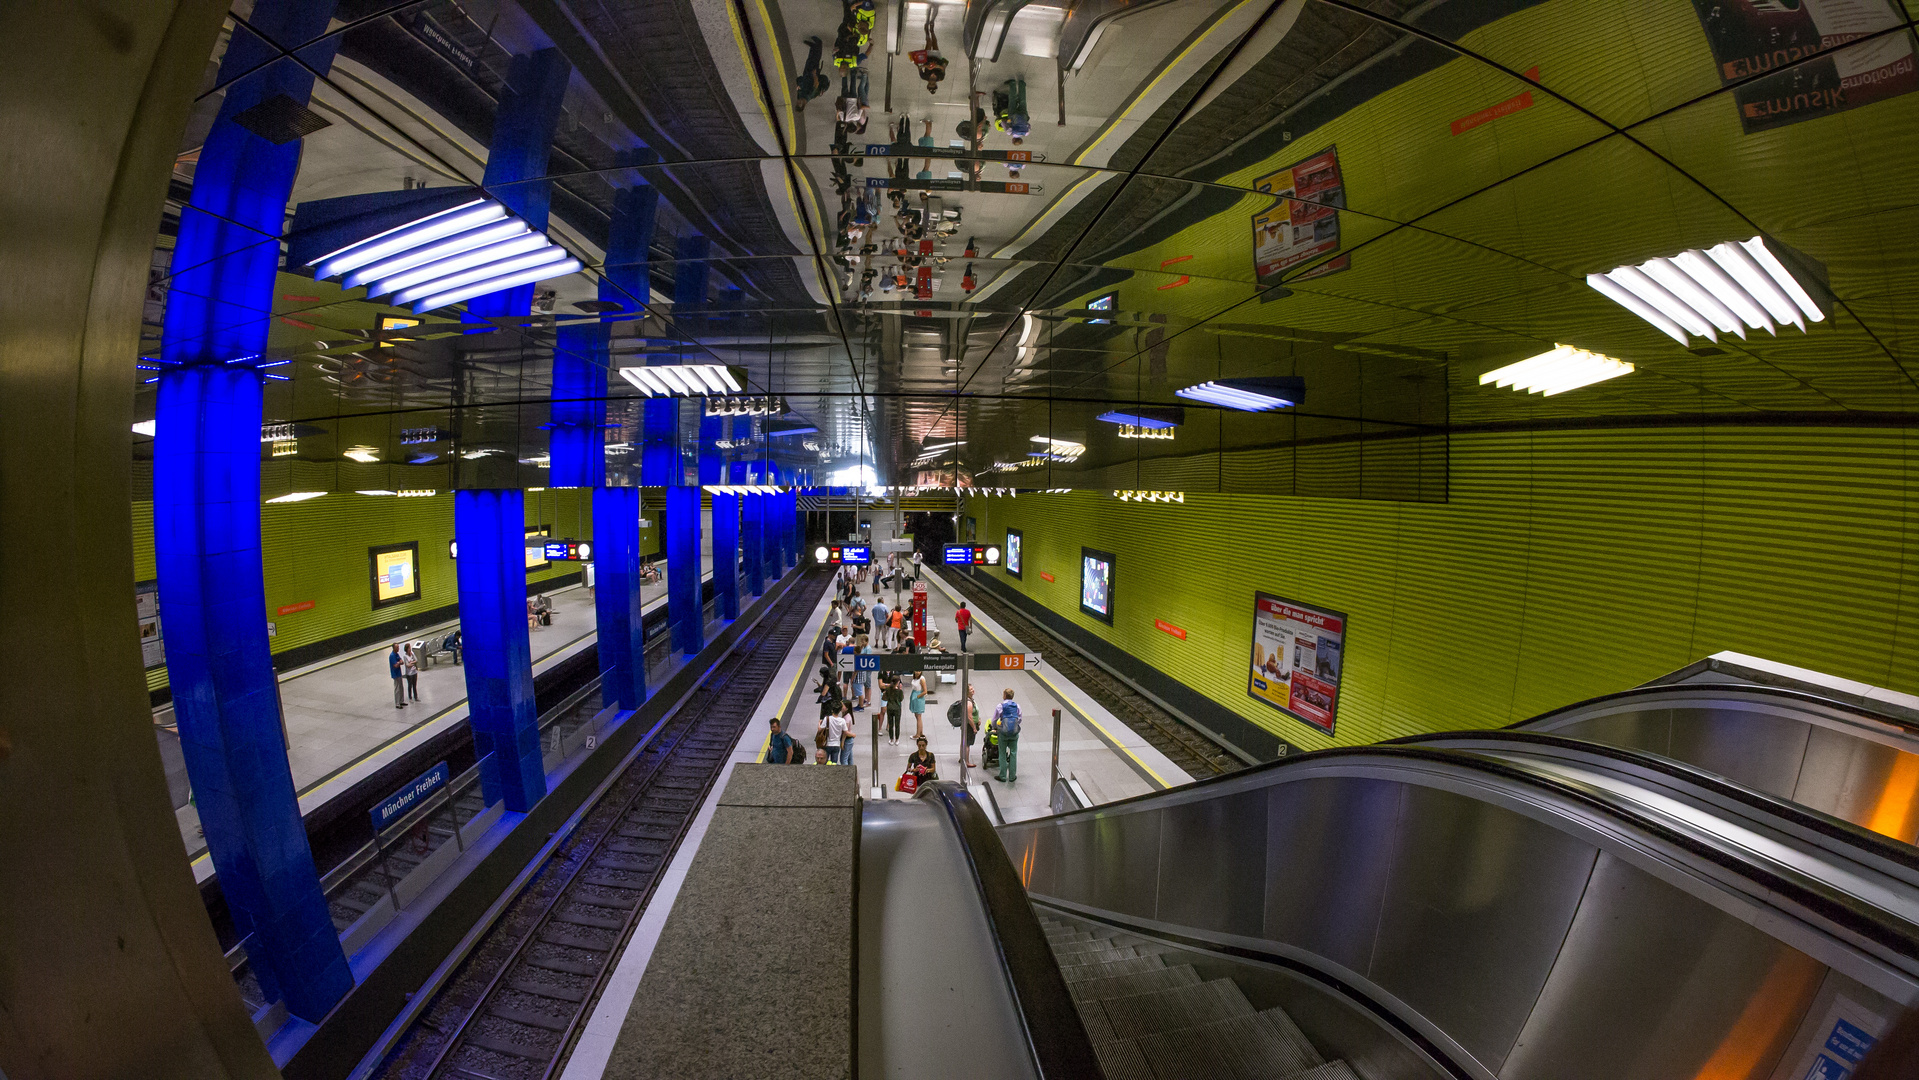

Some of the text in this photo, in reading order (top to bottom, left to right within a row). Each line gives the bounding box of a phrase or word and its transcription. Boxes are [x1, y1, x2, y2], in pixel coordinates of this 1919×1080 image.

[1270, 603, 1283, 613] über
[1282, 607, 1291, 616] die
[1291, 611, 1304, 620] man
[859, 658, 876, 668] U6
[923, 663, 955, 671] Marienplatz
[1004, 657, 1020, 667] U3
[588, 737, 594, 748] 2
[1279, 745, 1286, 755] 2
[381, 771, 441, 820] Münchner Freiheit
